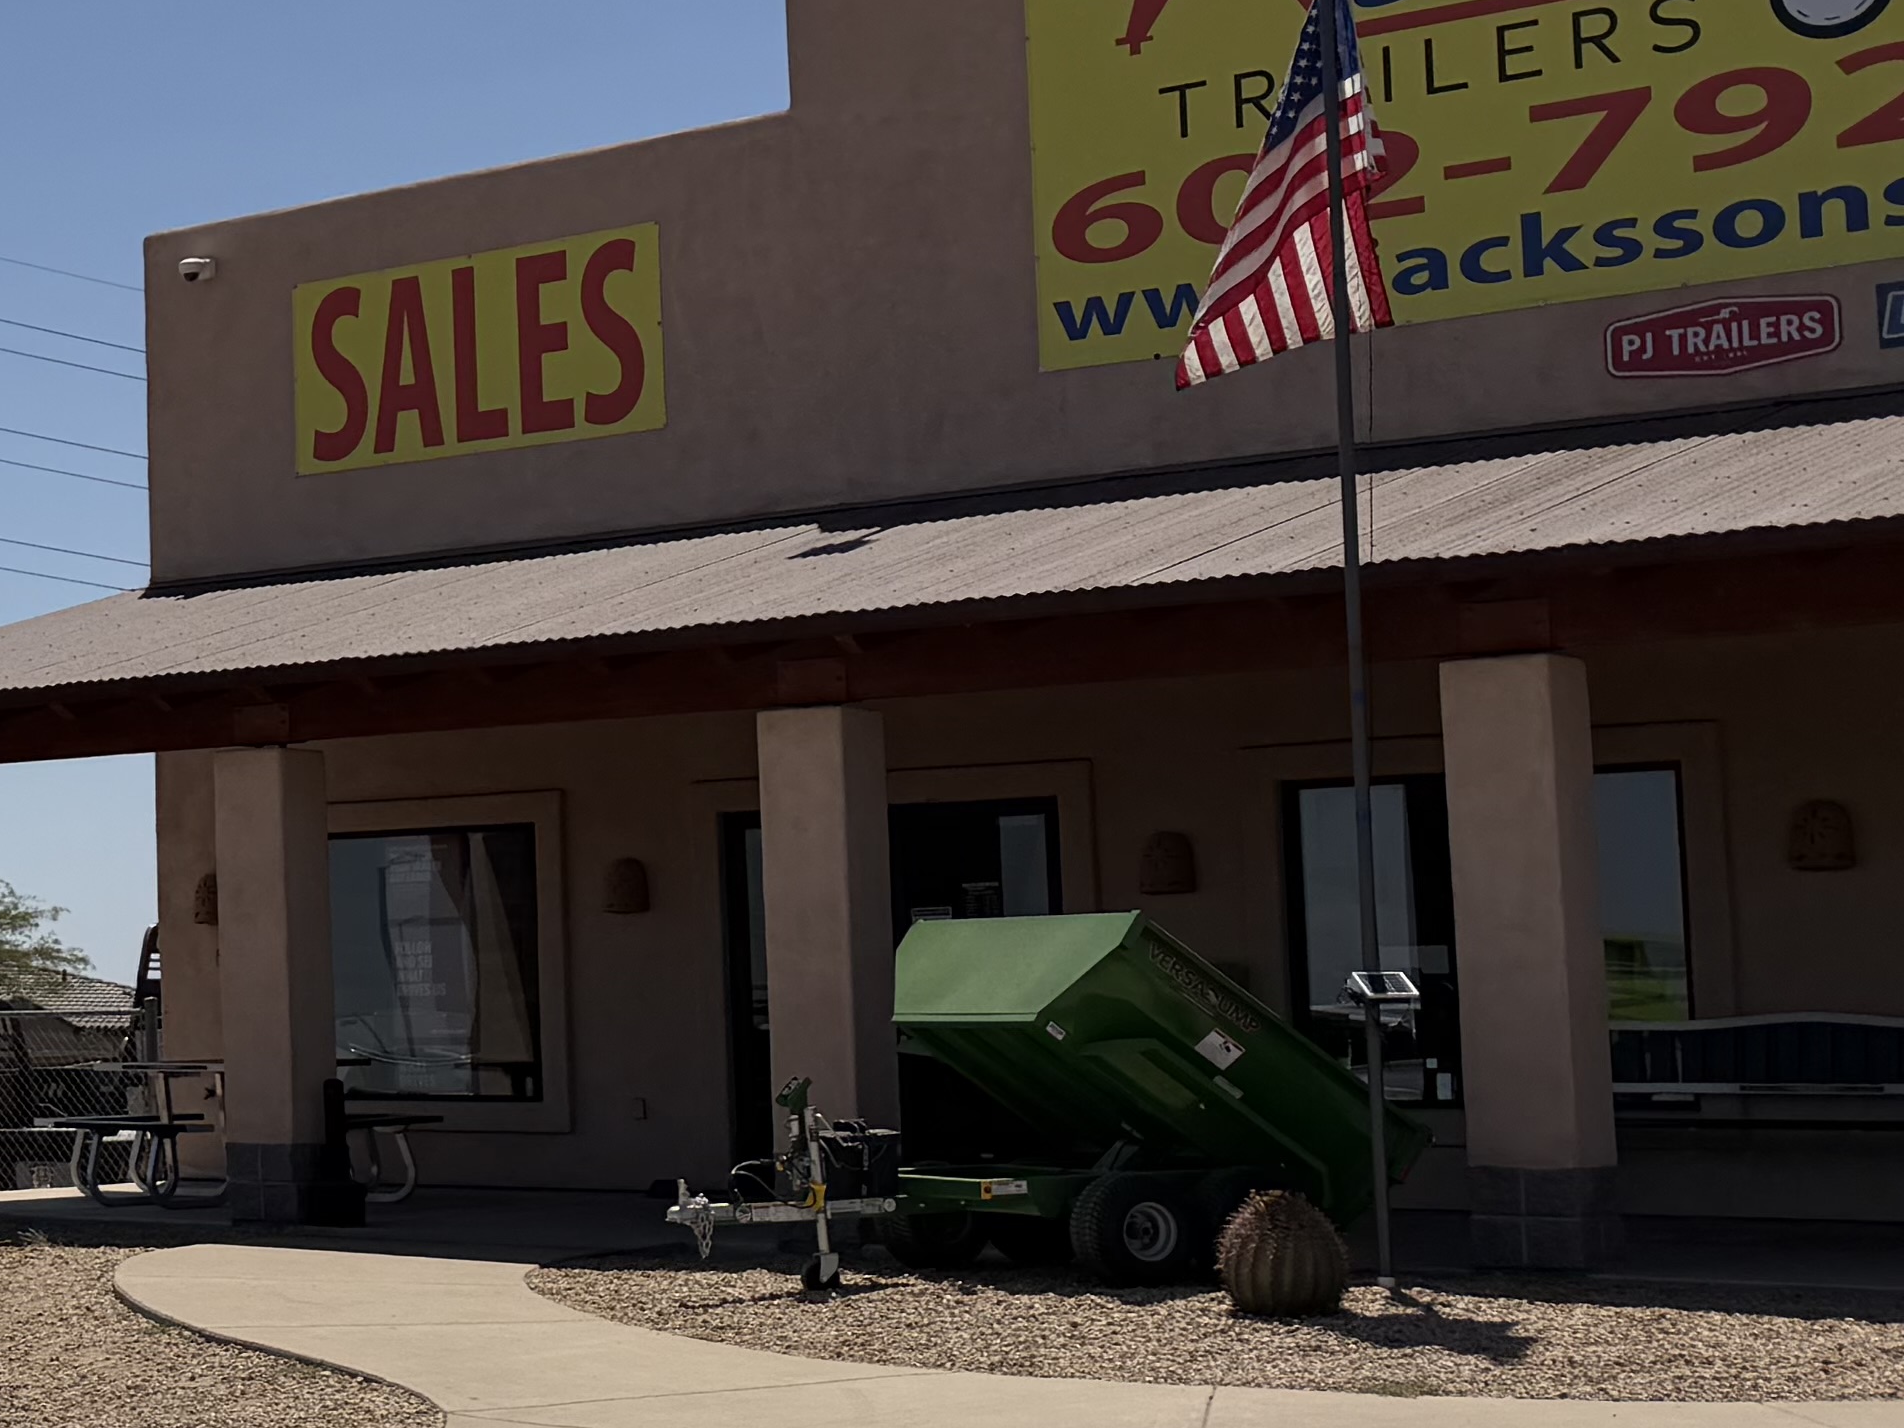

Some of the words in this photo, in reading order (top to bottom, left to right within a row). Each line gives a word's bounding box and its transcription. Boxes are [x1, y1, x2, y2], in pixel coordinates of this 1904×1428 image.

[311, 239, 645, 462] SALES
[1622, 329, 1653, 362] PJ
[1666, 310, 1824, 357] TRAILERS
